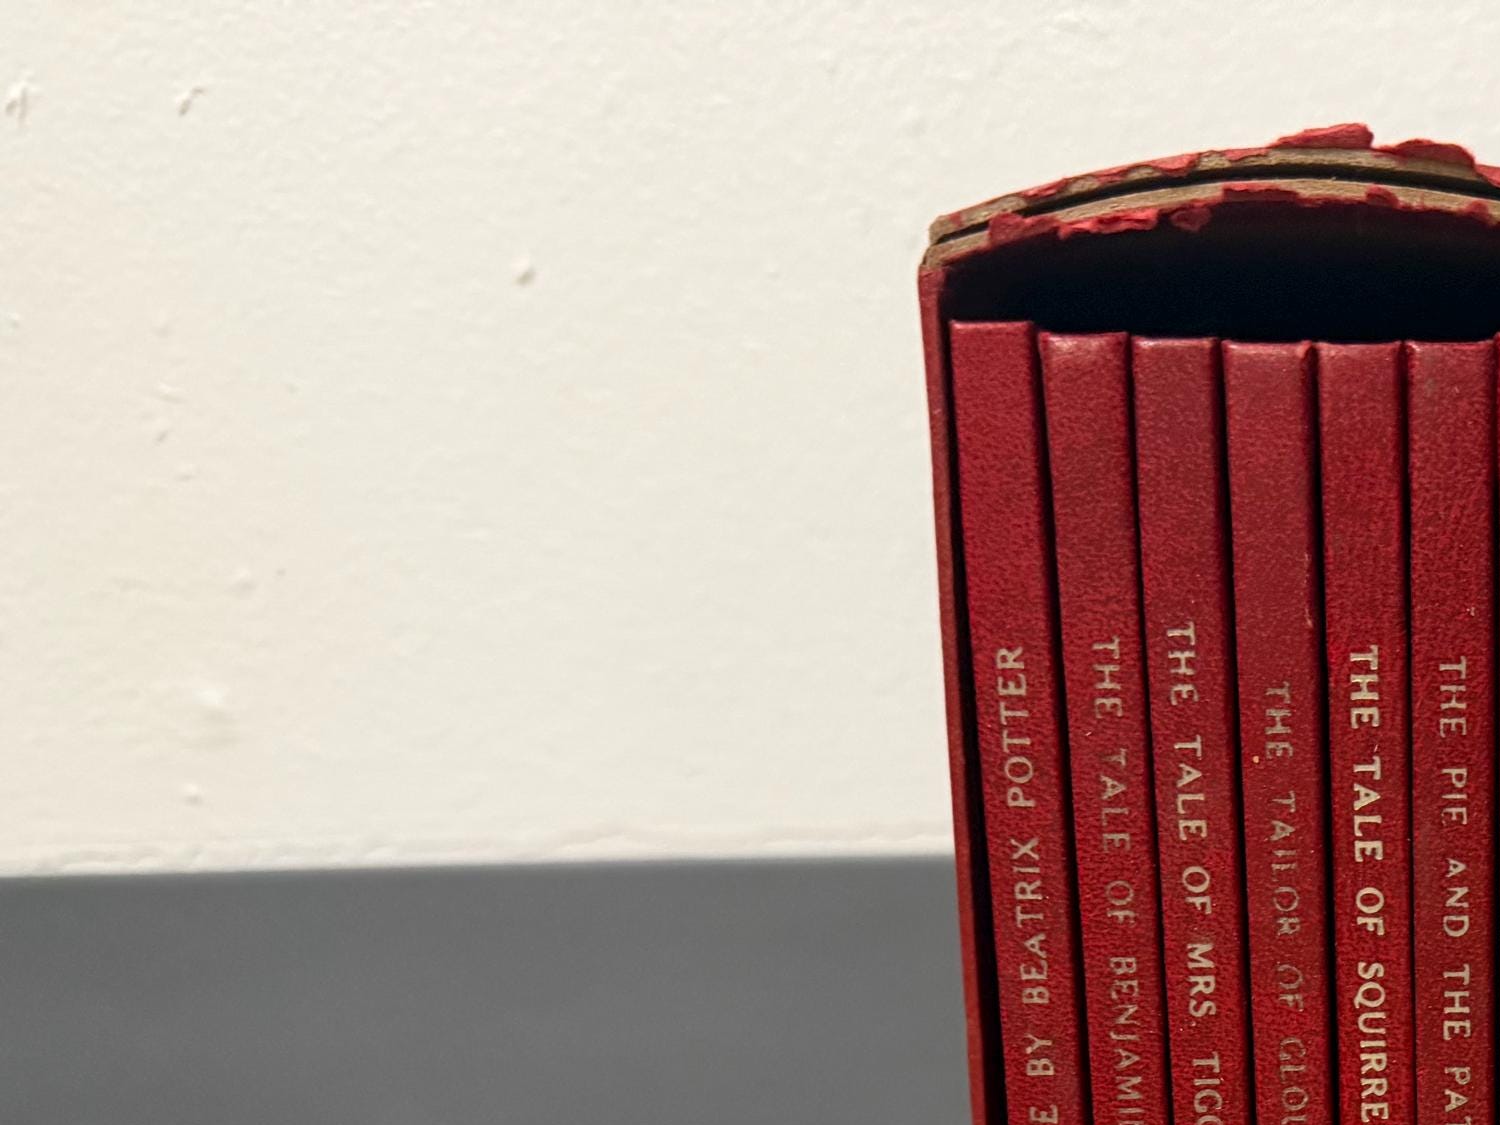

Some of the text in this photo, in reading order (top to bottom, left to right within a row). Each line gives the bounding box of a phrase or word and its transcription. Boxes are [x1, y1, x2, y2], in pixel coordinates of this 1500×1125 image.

[1092, 636, 1123, 718] THE
[1167, 622, 1199, 706] THE
[1349, 645, 1380, 729] THE
[1438, 656, 1467, 738] THE
[996, 646, 1035, 808] POTTER
[1265, 682, 1294, 760] THE
[1099, 748, 1130, 852] TALE
[1174, 736, 1208, 841] TALE
[1352, 756, 1384, 863] TALE
[1105, 880, 1136, 925] OF
[1183, 866, 1212, 915] OF
[1270, 791, 1301, 936] TAILOR
[1442, 858, 1470, 938] AND
[1010, 837, 1049, 1004] BEATRIX
[1356, 887, 1385, 936] OF
[1277, 964, 1304, 1011] OF
[1443, 963, 1471, 1041] THE
[1026, 1033, 1054, 1075] BY
